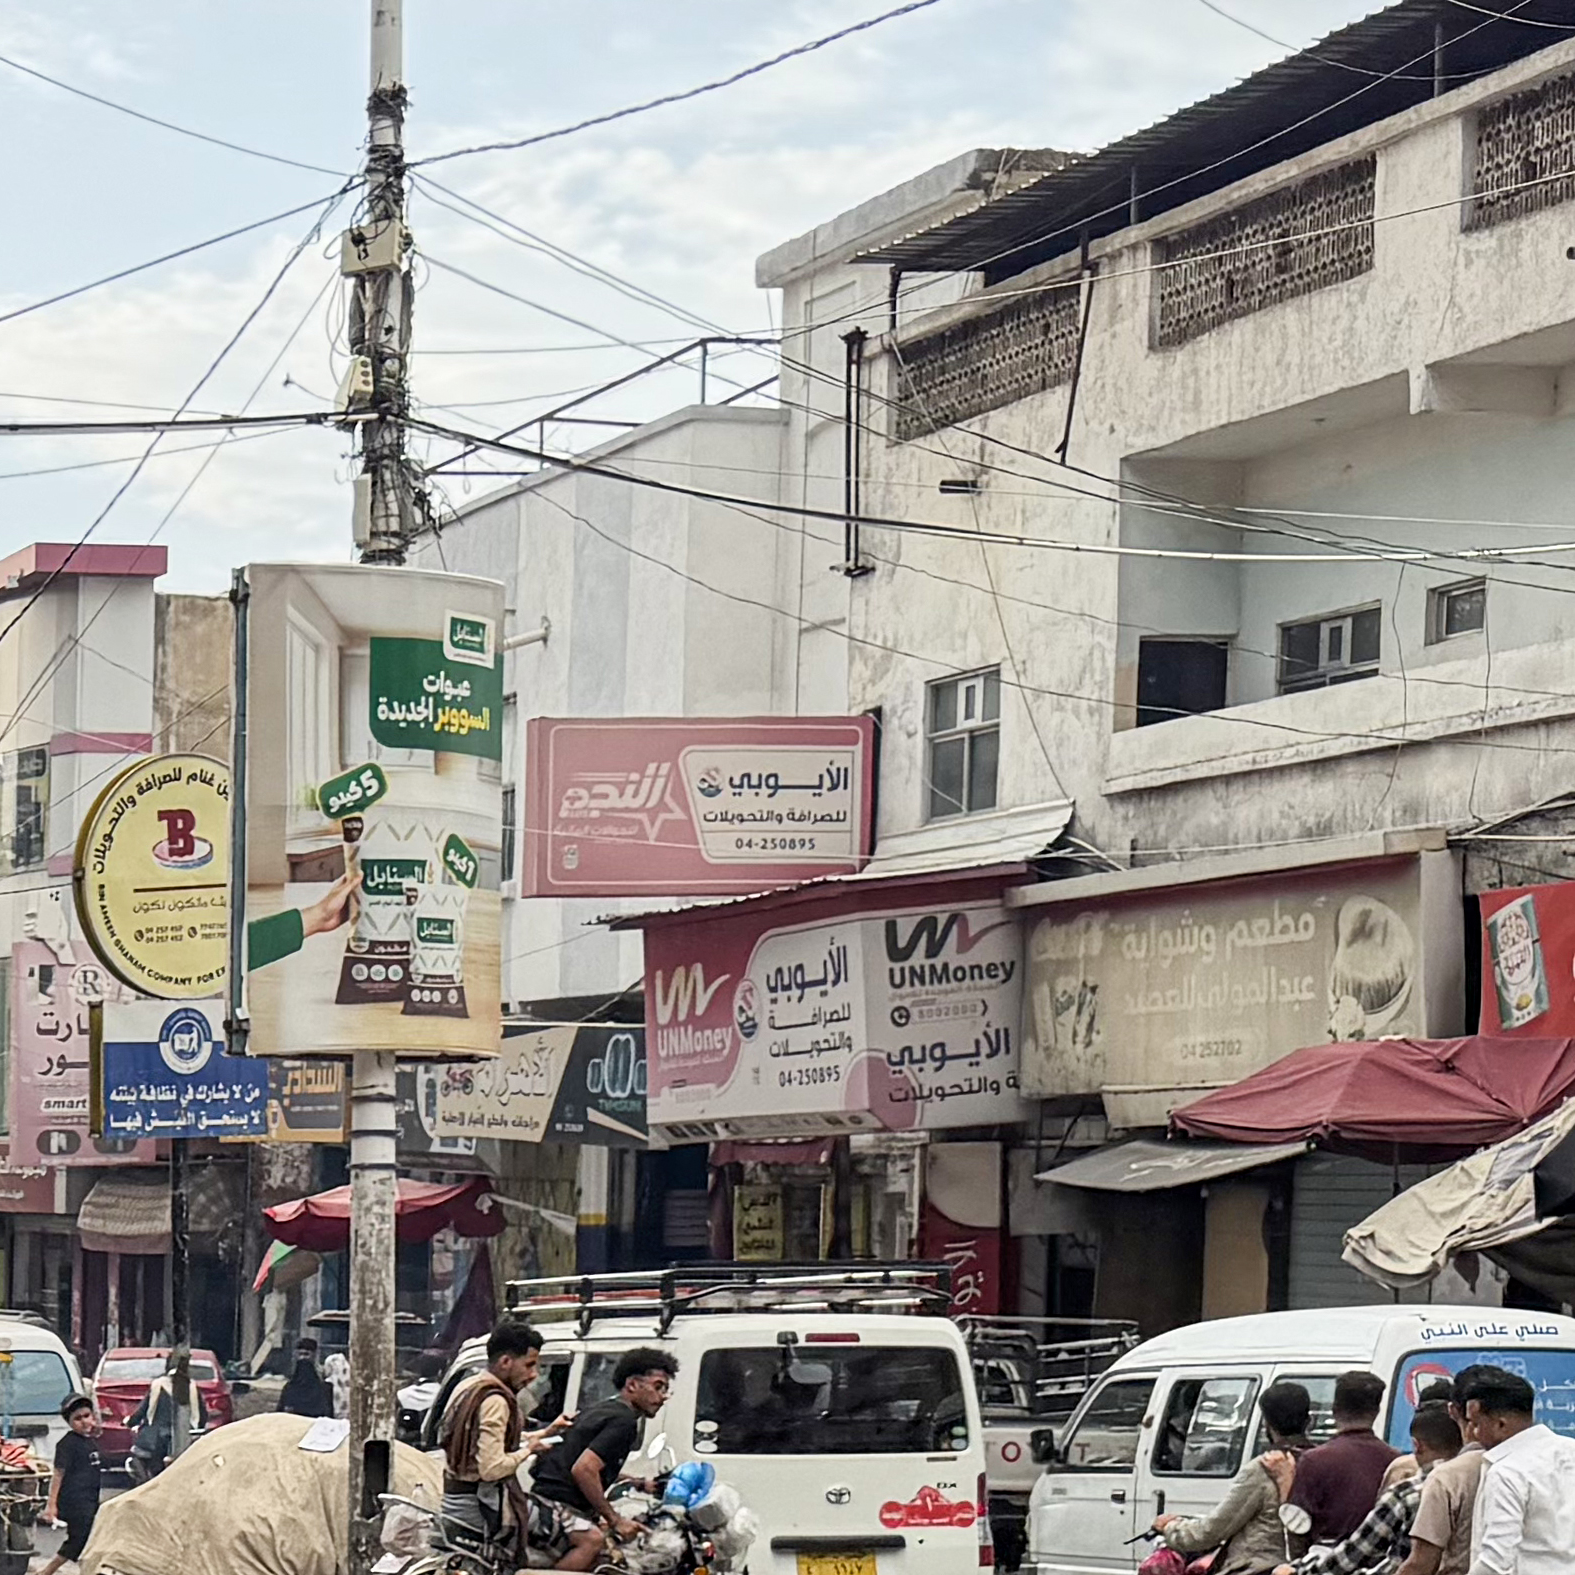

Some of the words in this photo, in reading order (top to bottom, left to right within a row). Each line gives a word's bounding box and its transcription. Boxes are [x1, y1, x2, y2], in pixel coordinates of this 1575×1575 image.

[422, 670, 471, 702] عبوات
[376, 697, 433, 729] الجديدة
[136, 767, 183, 796] للصرافة
[186, 768, 216, 788] غنام
[728, 759, 848, 800] الأيوبي
[559, 762, 671, 818] النجم
[703, 808, 785, 826] والتحويلات
[787, 808, 847, 826] للصرافة
[92, 794, 138, 875] والتحويلات
[735, 837, 816, 852] 04-250895
[367, 864, 423, 890] السنابل
[1121, 909, 1217, 967] وشواية
[1226, 899, 1317, 961] مطعم
[146, 969, 194, 986] COMPANY
[197, 972, 214, 985] FOR
[765, 935, 848, 1005] الأيوبي
[888, 959, 1016, 990] UNMoney
[35, 1011, 90, 1043] ارت
[767, 1002, 851, 1030] للصرافة
[657, 1024, 733, 1060] UNMoney
[768, 1030, 853, 1060] والتحويلات
[886, 1022, 1011, 1075] الأيوبي
[38, 1054, 90, 1077] ور
[778, 1065, 841, 1088] 04-250895
[139, 1083, 177, 1103] نظافة
[179, 1085, 194, 1108] في
[195, 1082, 230, 1104] يشارك
[231, 1084, 243, 1100] لا
[243, 1083, 261, 1103] من
[888, 1077, 1001, 1104] والتحويلات
[43, 1098, 89, 1110] smart
[109, 1110, 143, 1131] فيها
[196, 1109, 249, 1131] يستحق
[250, 1109, 261, 1126] لا
[1420, 1322, 1469, 1345] النبي
[1473, 1322, 1510, 1340] على
[1515, 1323, 1560, 1342] صلي
